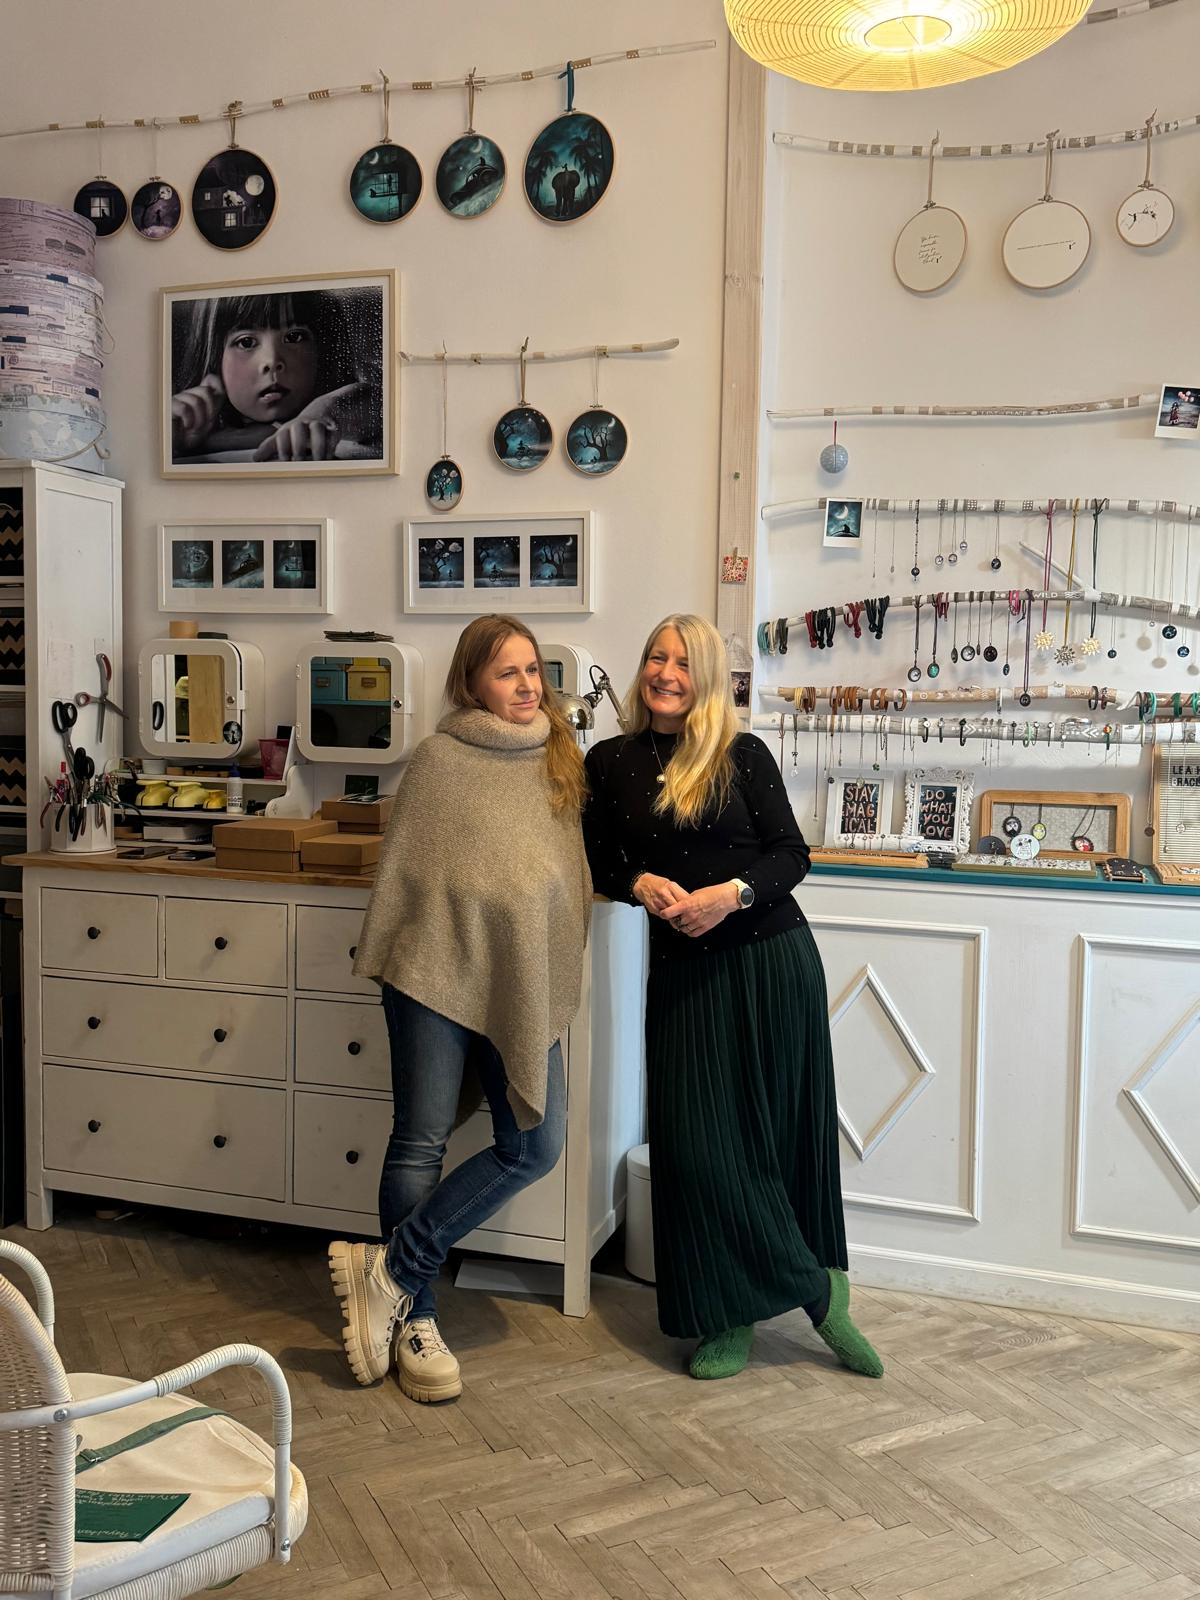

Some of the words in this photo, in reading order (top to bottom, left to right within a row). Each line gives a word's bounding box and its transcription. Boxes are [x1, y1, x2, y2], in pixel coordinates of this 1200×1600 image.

[845, 785, 876, 802] STAY
[925, 789, 945, 800] DO
[845, 802, 875, 818] MAG
[920, 801, 953, 814] WHAT
[844, 817, 875, 833] ICAL
[923, 813, 951, 825] YOU
[918, 824, 953, 838] LOVE
